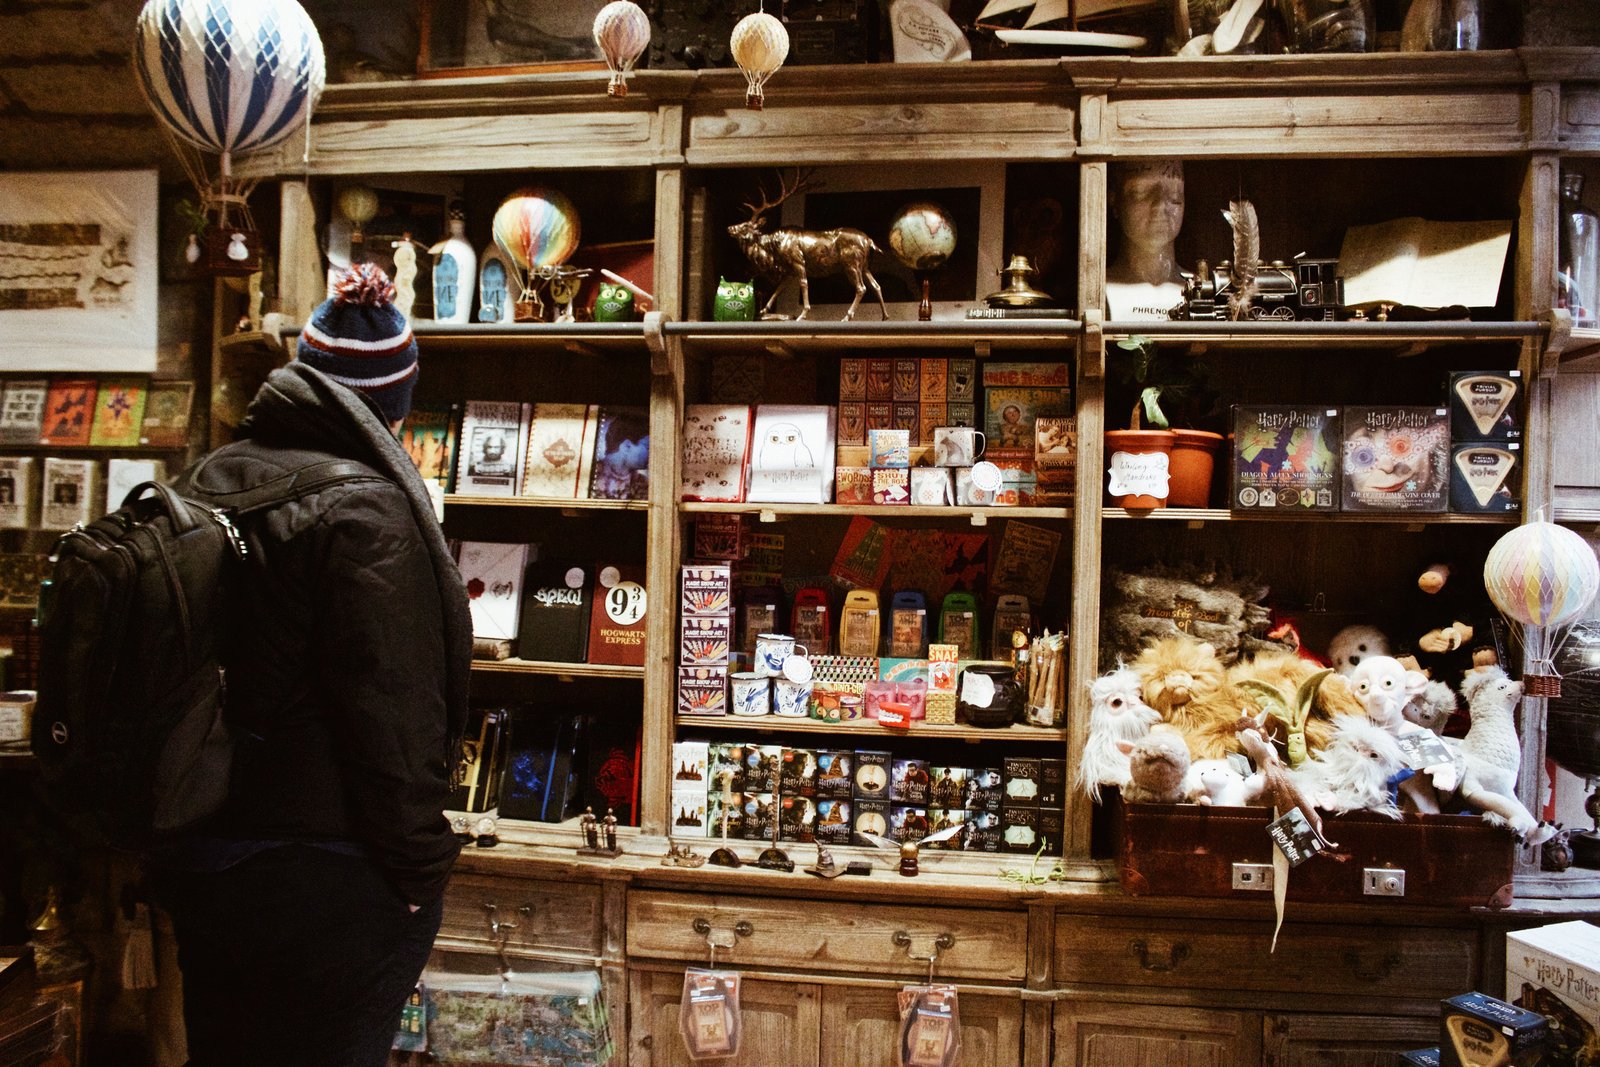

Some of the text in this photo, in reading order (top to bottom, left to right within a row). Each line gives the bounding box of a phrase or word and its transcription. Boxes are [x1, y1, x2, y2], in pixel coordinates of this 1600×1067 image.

[1132, 306, 1168, 315] PHRENO
[1256, 410, 1320, 431] Harry Potter
[1365, 410, 1428, 431] Harry Potter
[899, 613, 917, 621] TOP
[600, 629, 646, 638] HOGWARTS
[605, 637, 641, 645] EXPRESS
[929, 650, 958, 661] SNAP
[784, 777, 815, 787] Harry Potter
[818, 778, 851, 788] Harry Potter
[892, 780, 927, 791] Harry Potter
[984, 790, 1002, 800] Potter
[783, 823, 814, 834] Harry Potter
[818, 824, 851, 835] Harry Potter
[892, 827, 908, 837] Harry
[908, 827, 926, 837] Potter
[1271, 826, 1300, 861] Harry Potter
[1536, 959, 1600, 1003] Harry Potter
[923, 1018, 945, 1028] TOP
